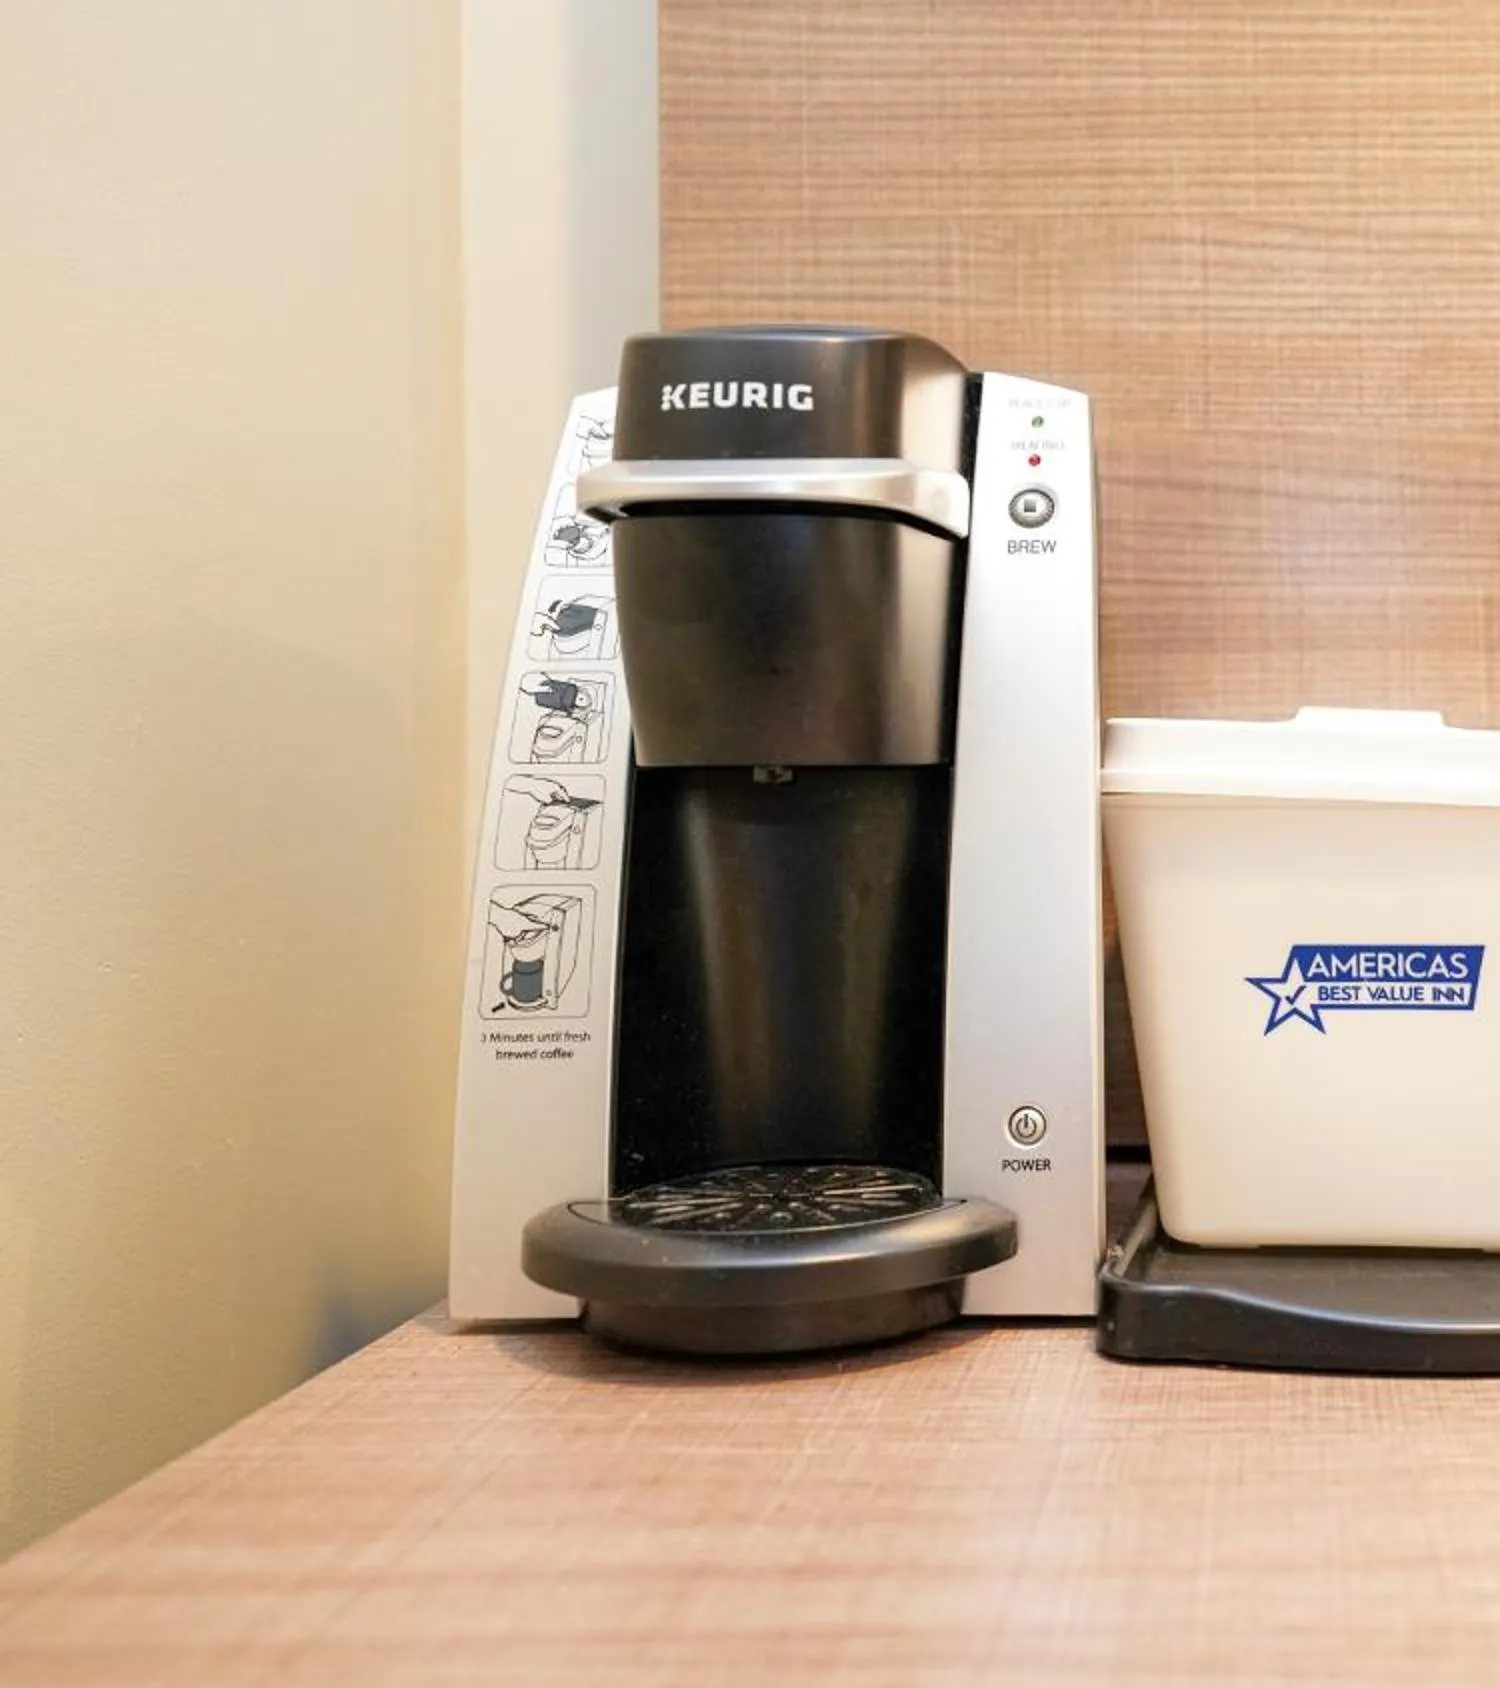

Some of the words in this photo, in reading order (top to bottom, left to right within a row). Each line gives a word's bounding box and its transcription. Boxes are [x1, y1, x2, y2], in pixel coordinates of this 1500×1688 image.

[659, 380, 815, 412] KEURIG
[1007, 539, 1057, 555] BREW
[1306, 952, 1469, 979] AMERICAS
[1317, 985, 1362, 1001] BEST
[1366, 985, 1425, 1002] VALUE
[1431, 986, 1465, 1002] INN
[489, 1031, 535, 1043] Minutes
[537, 1030, 563, 1043] until
[563, 1029, 592, 1043] fresh
[495, 1048, 538, 1061] brewed
[539, 1047, 575, 1061] coffee
[1001, 1158, 1052, 1173] POWER
